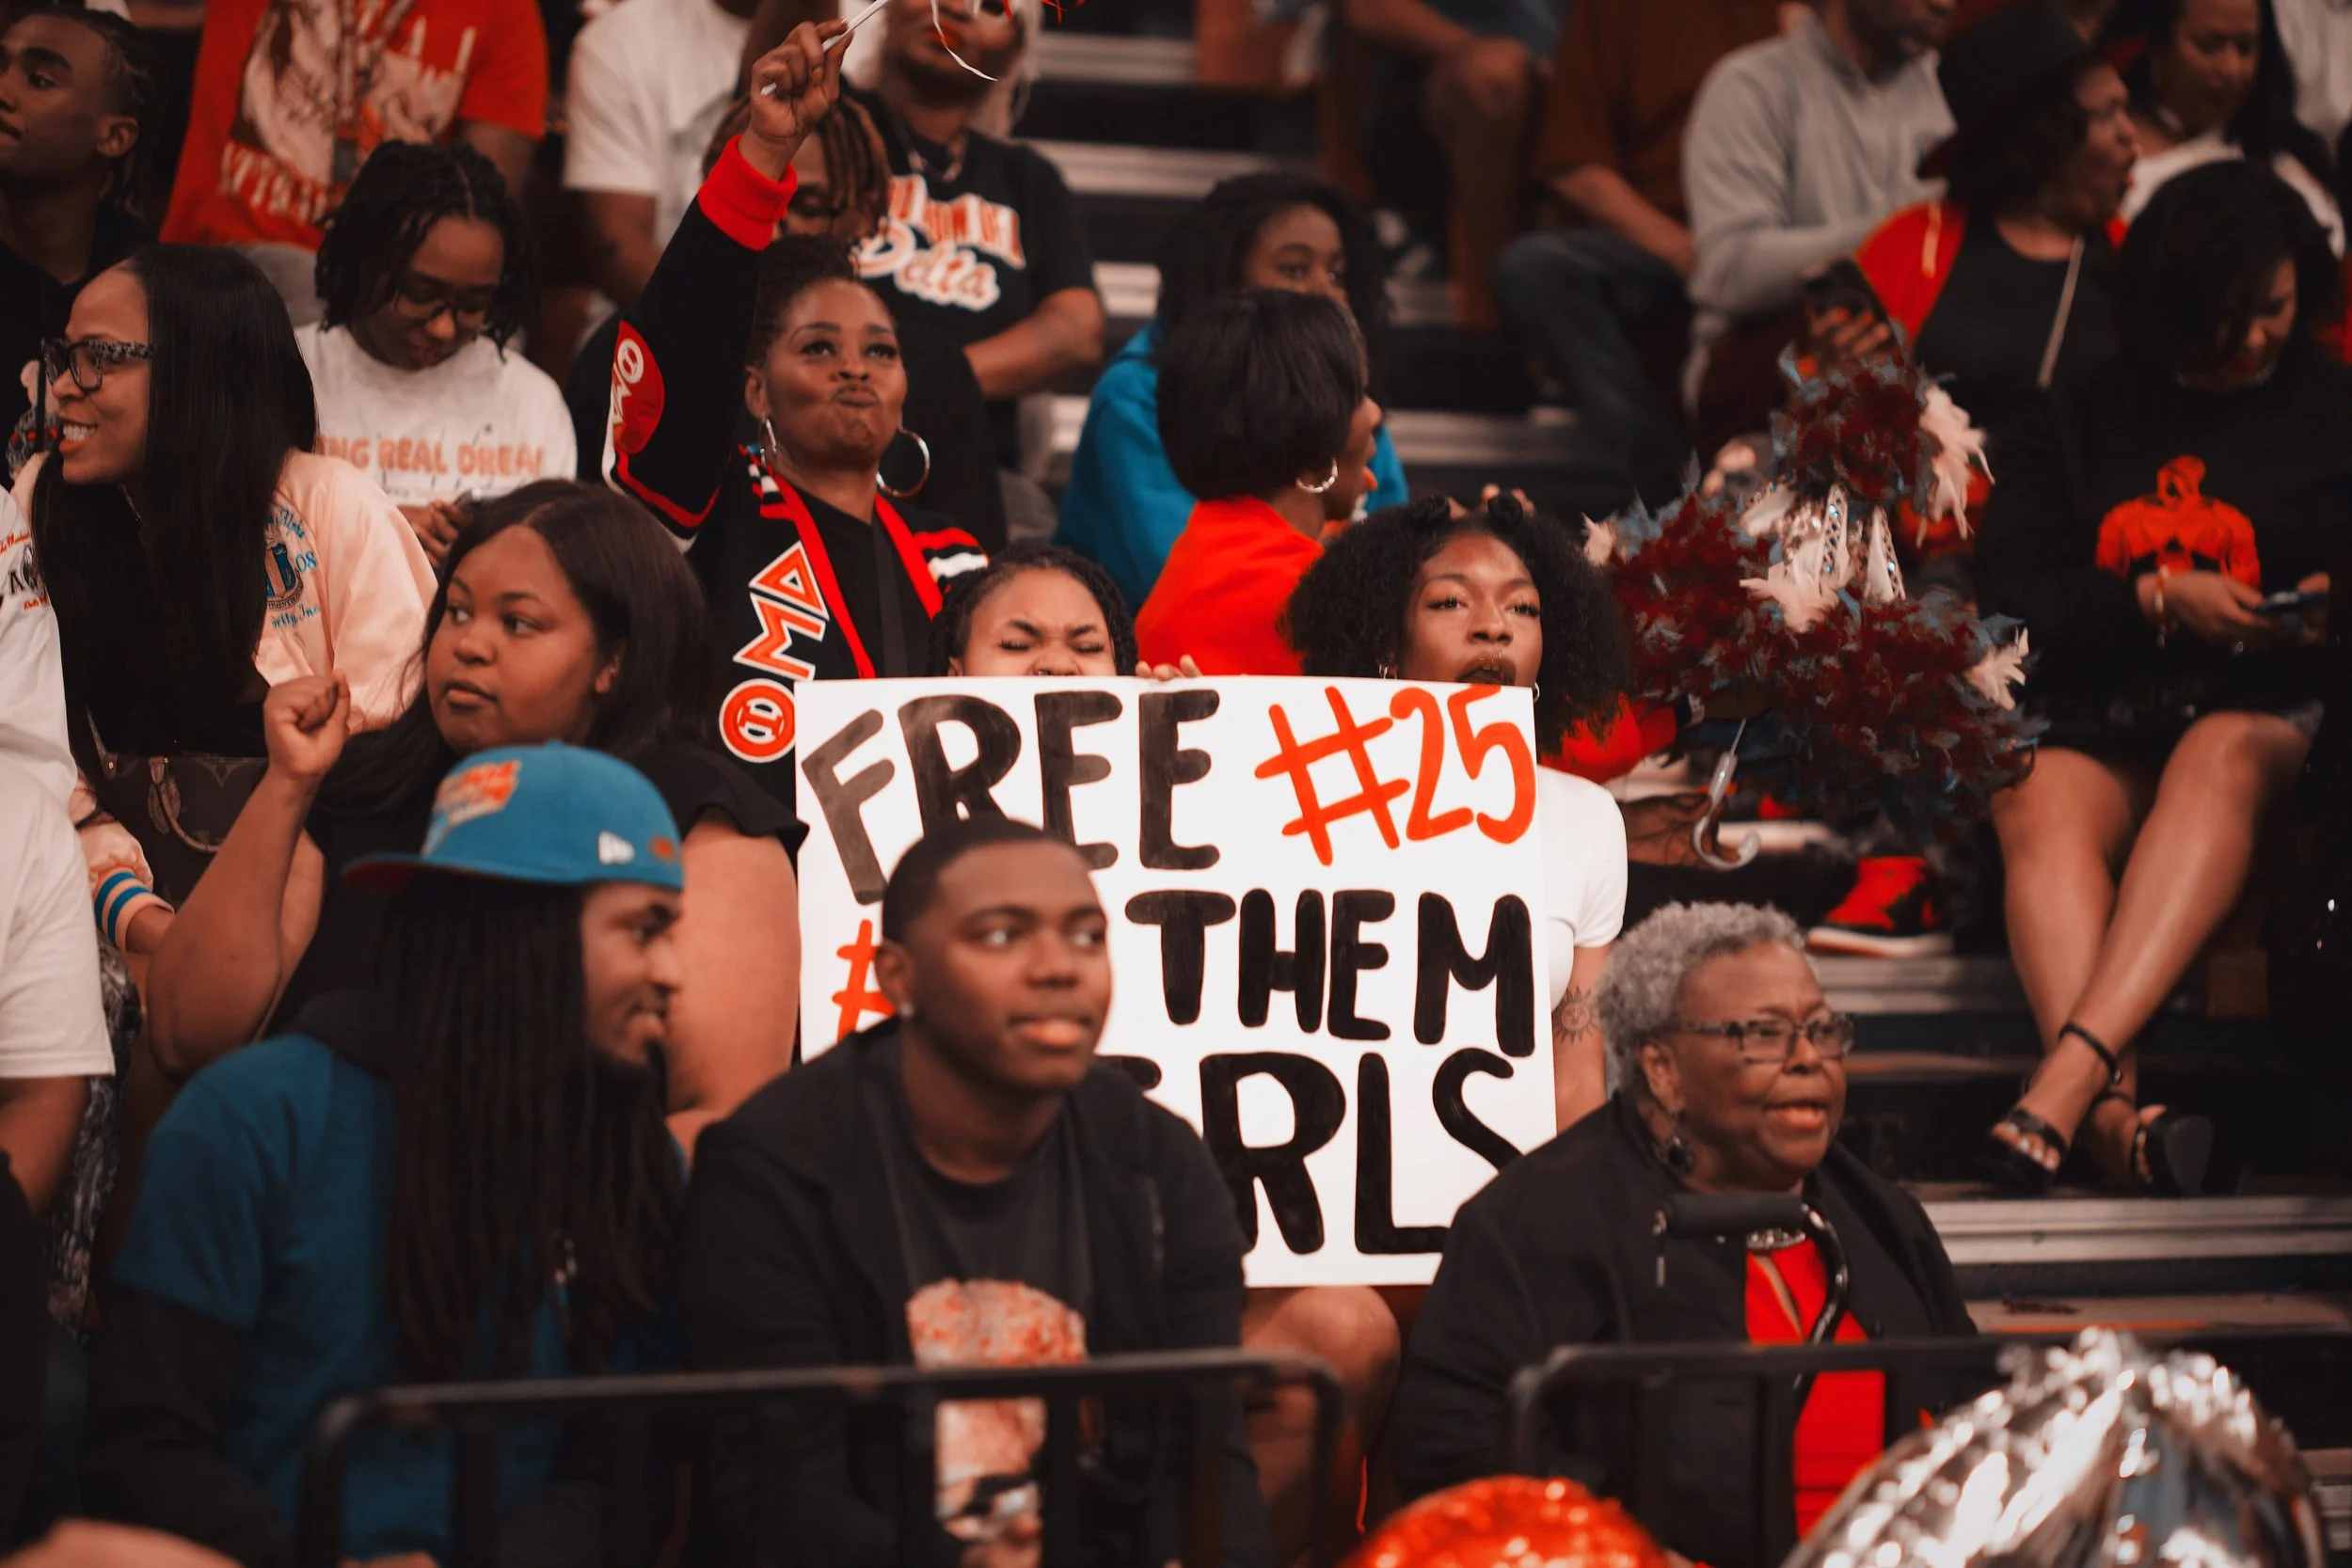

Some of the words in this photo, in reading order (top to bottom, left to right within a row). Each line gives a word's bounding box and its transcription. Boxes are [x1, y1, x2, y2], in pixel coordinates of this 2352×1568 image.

[377, 436, 449, 475] REAL
[801, 689, 1221, 905] FREE
[1254, 684, 1538, 867] #25
[1124, 887, 1536, 1058] THEM
[1101, 1047, 1524, 1257] RLS
